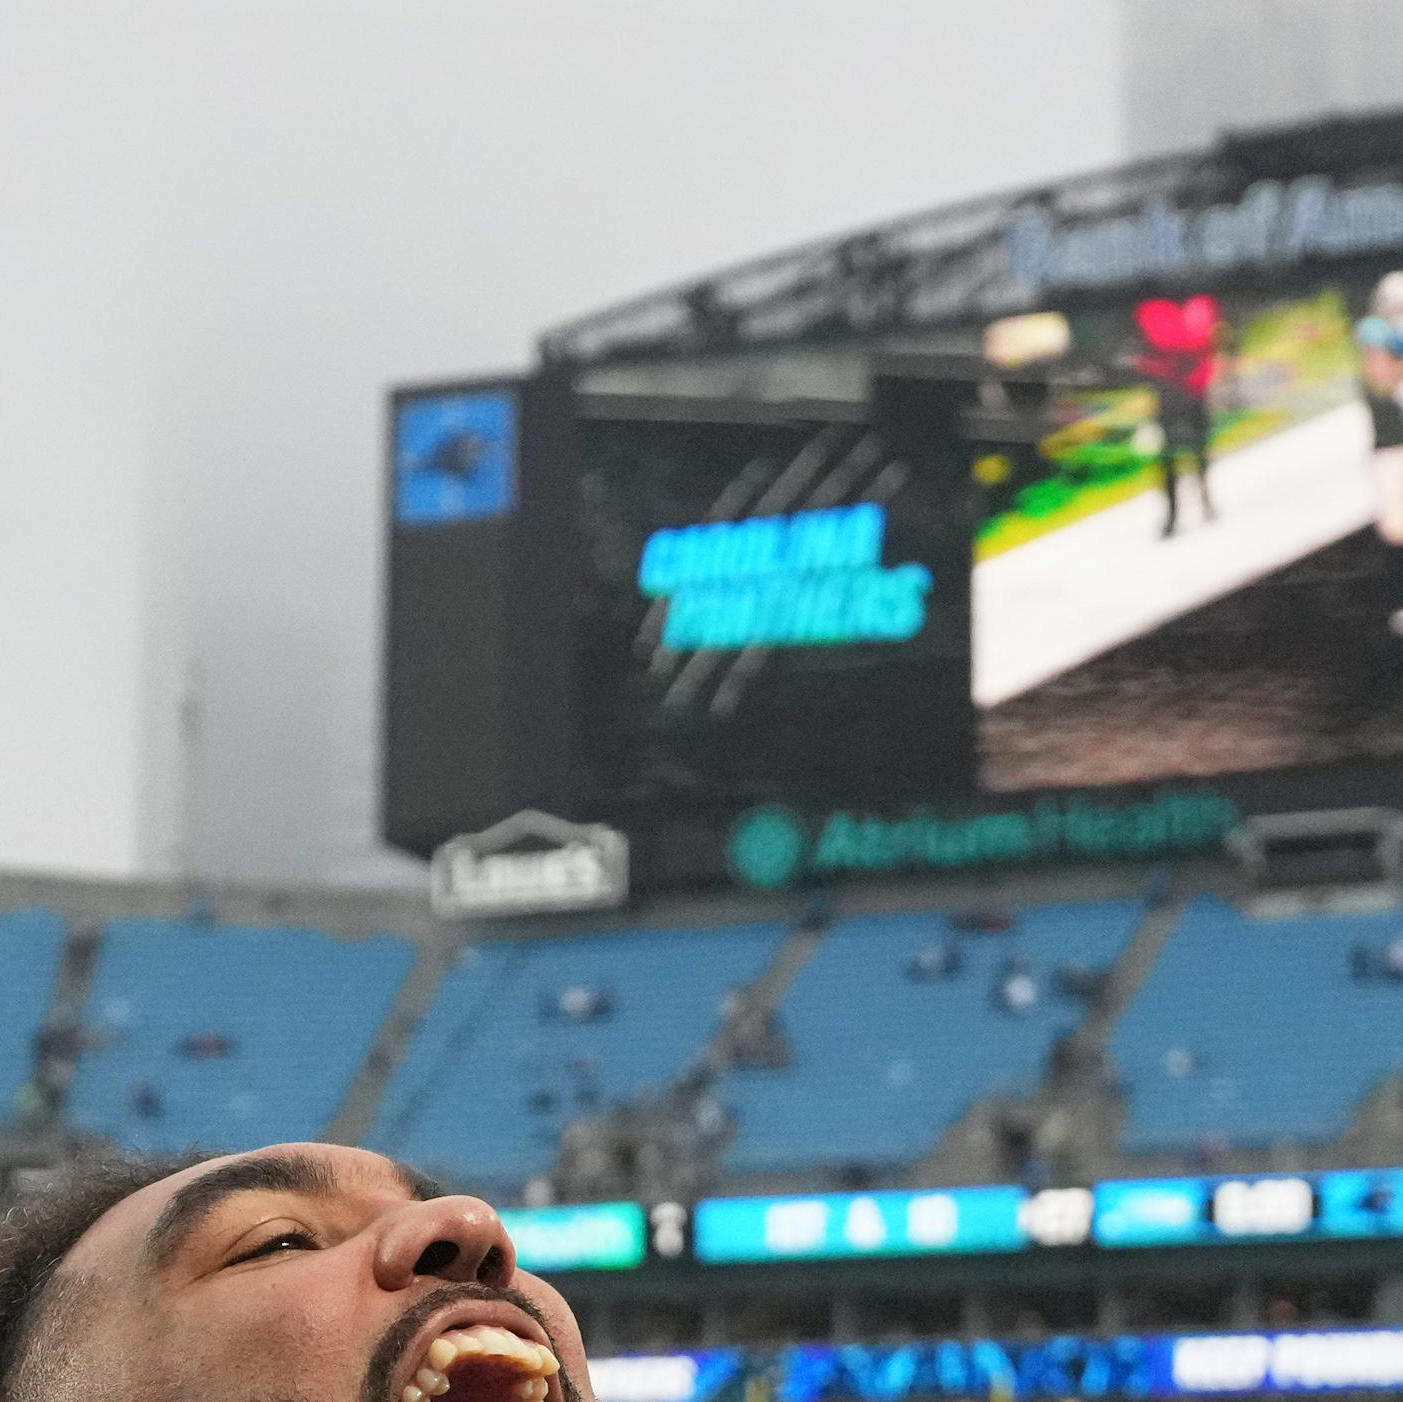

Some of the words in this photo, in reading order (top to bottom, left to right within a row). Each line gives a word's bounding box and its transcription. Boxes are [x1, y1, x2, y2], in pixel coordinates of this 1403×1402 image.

[1200, 180, 1284, 265] of
[816, 810, 1029, 867] Atrium
[1032, 792, 1239, 852] Health
